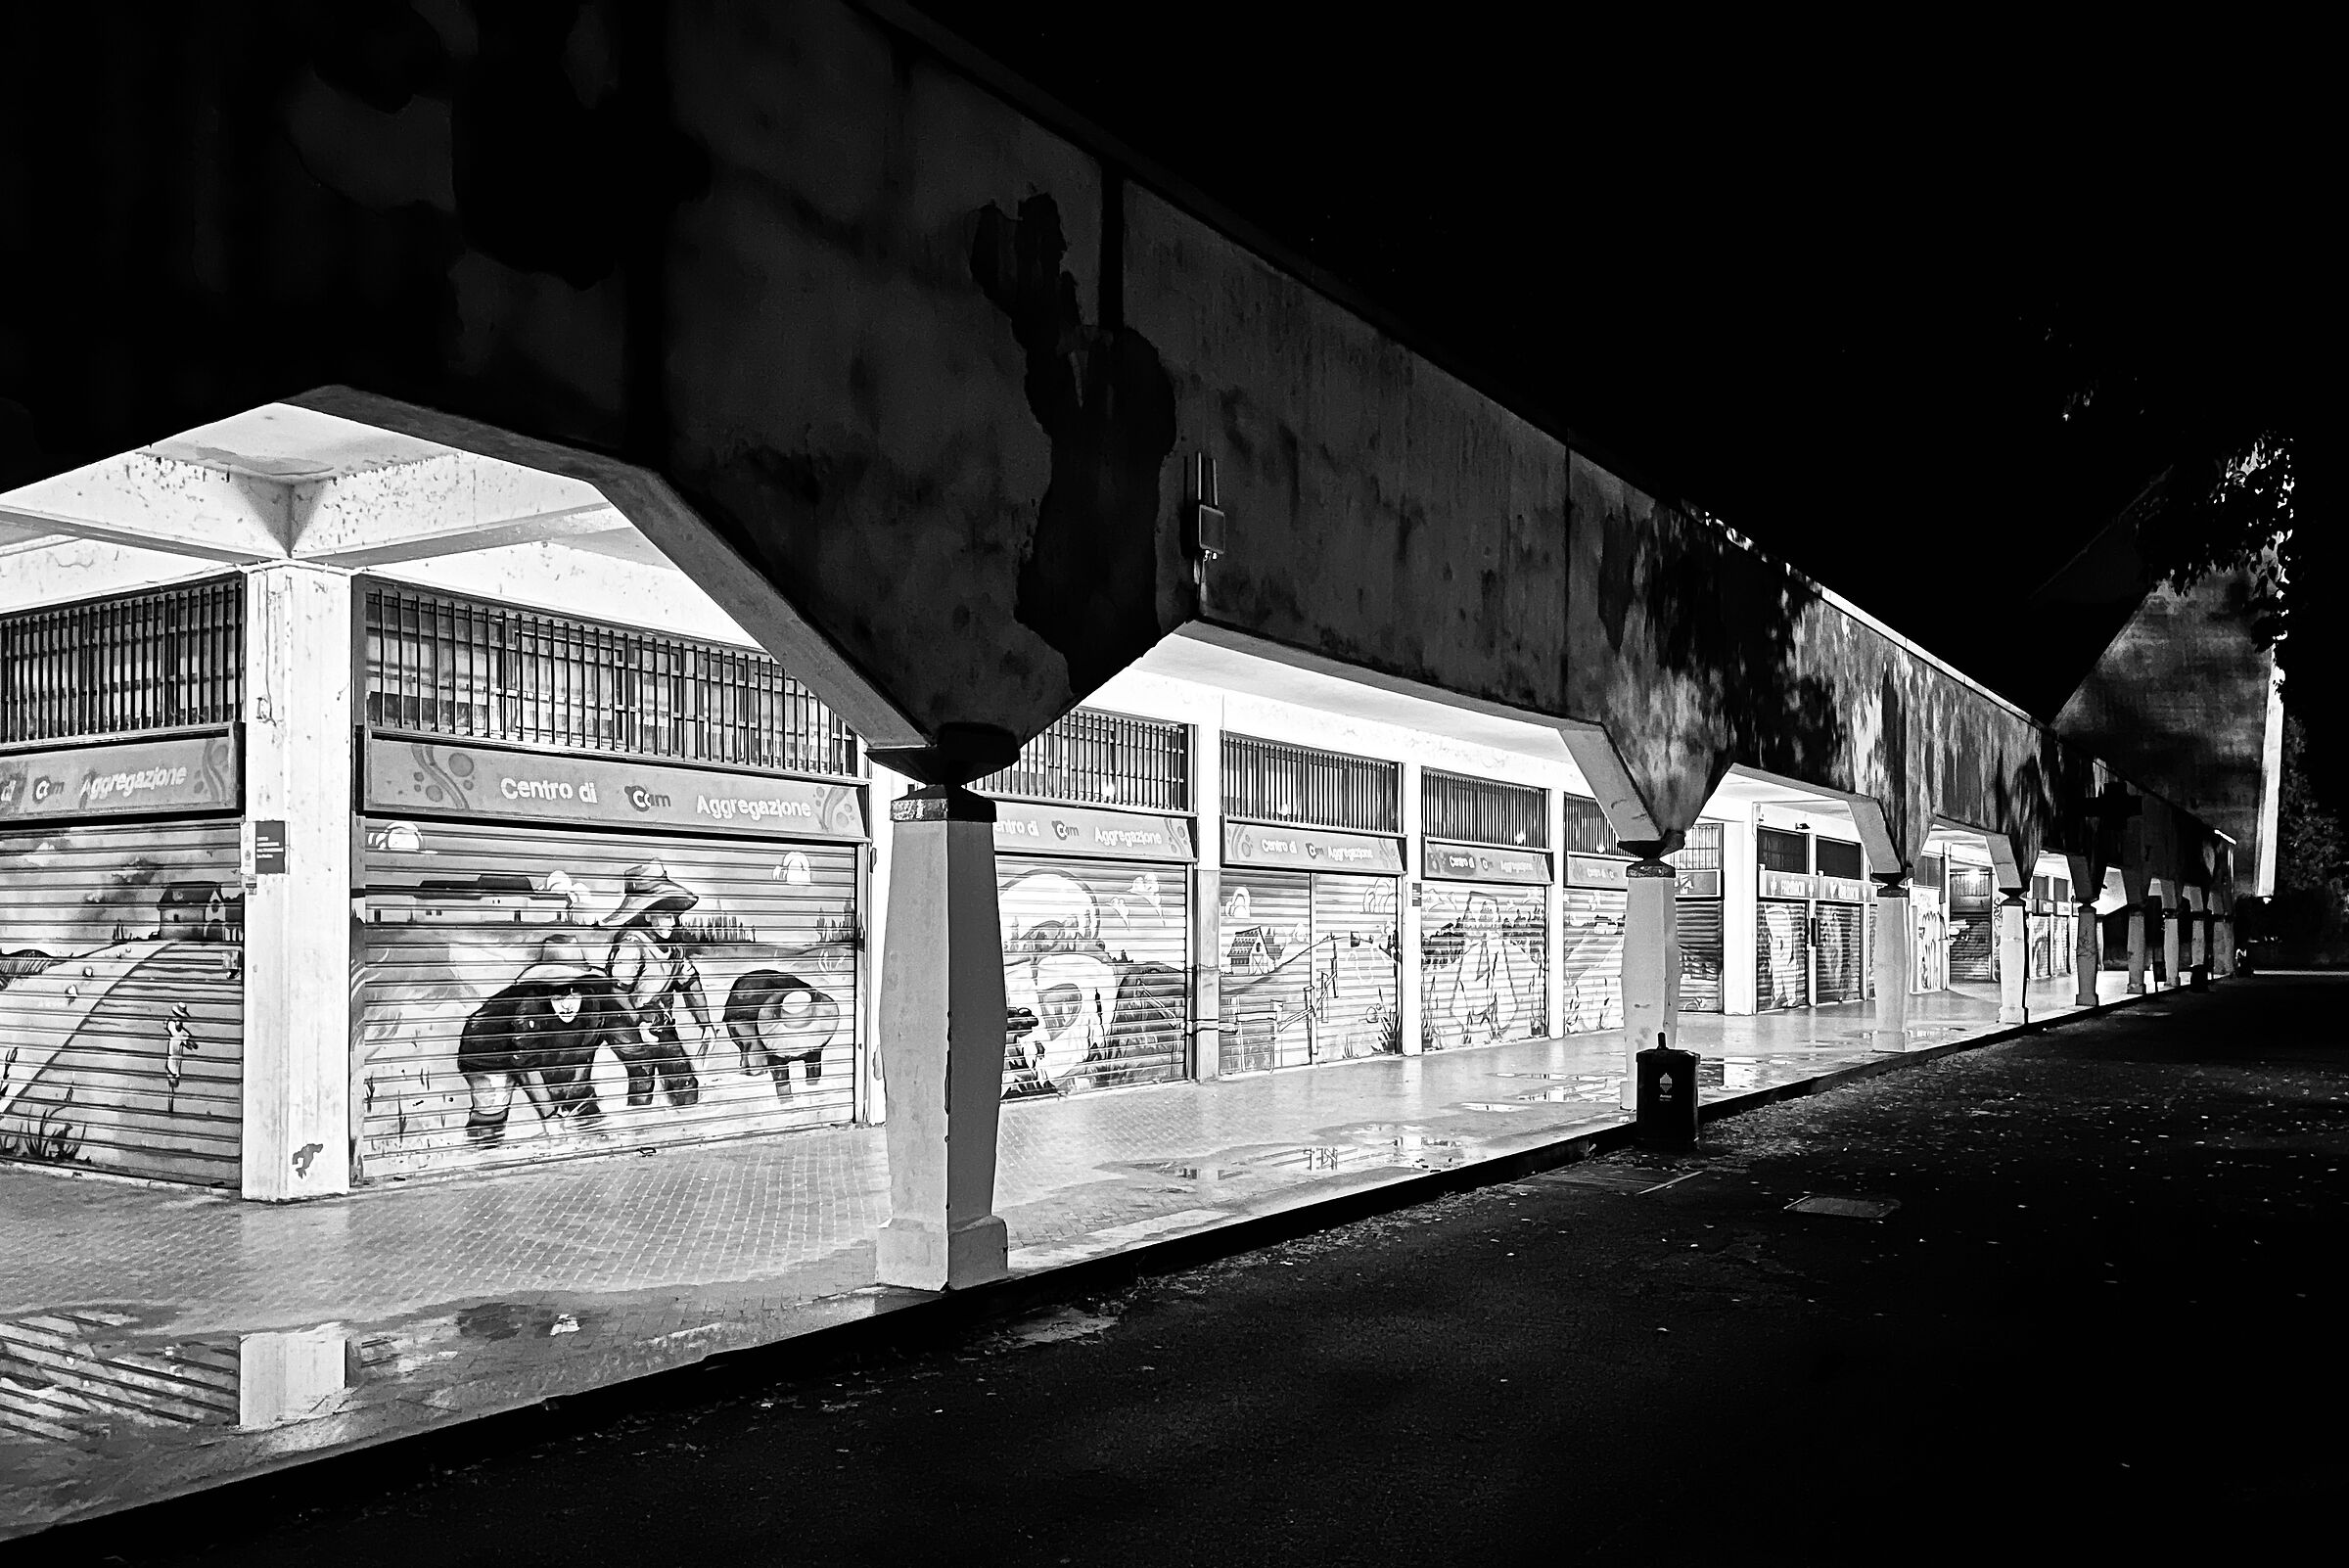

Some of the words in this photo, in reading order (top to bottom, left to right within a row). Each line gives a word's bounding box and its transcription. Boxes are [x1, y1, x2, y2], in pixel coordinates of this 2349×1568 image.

[78, 766, 187, 800] Aggregazione
[500, 777, 574, 801] Centro
[578, 782, 598, 804] di
[696, 794, 811, 821] Aggregazione
[994, 819, 1025, 835] entro
[1094, 825, 1162, 848] Aggregazione
